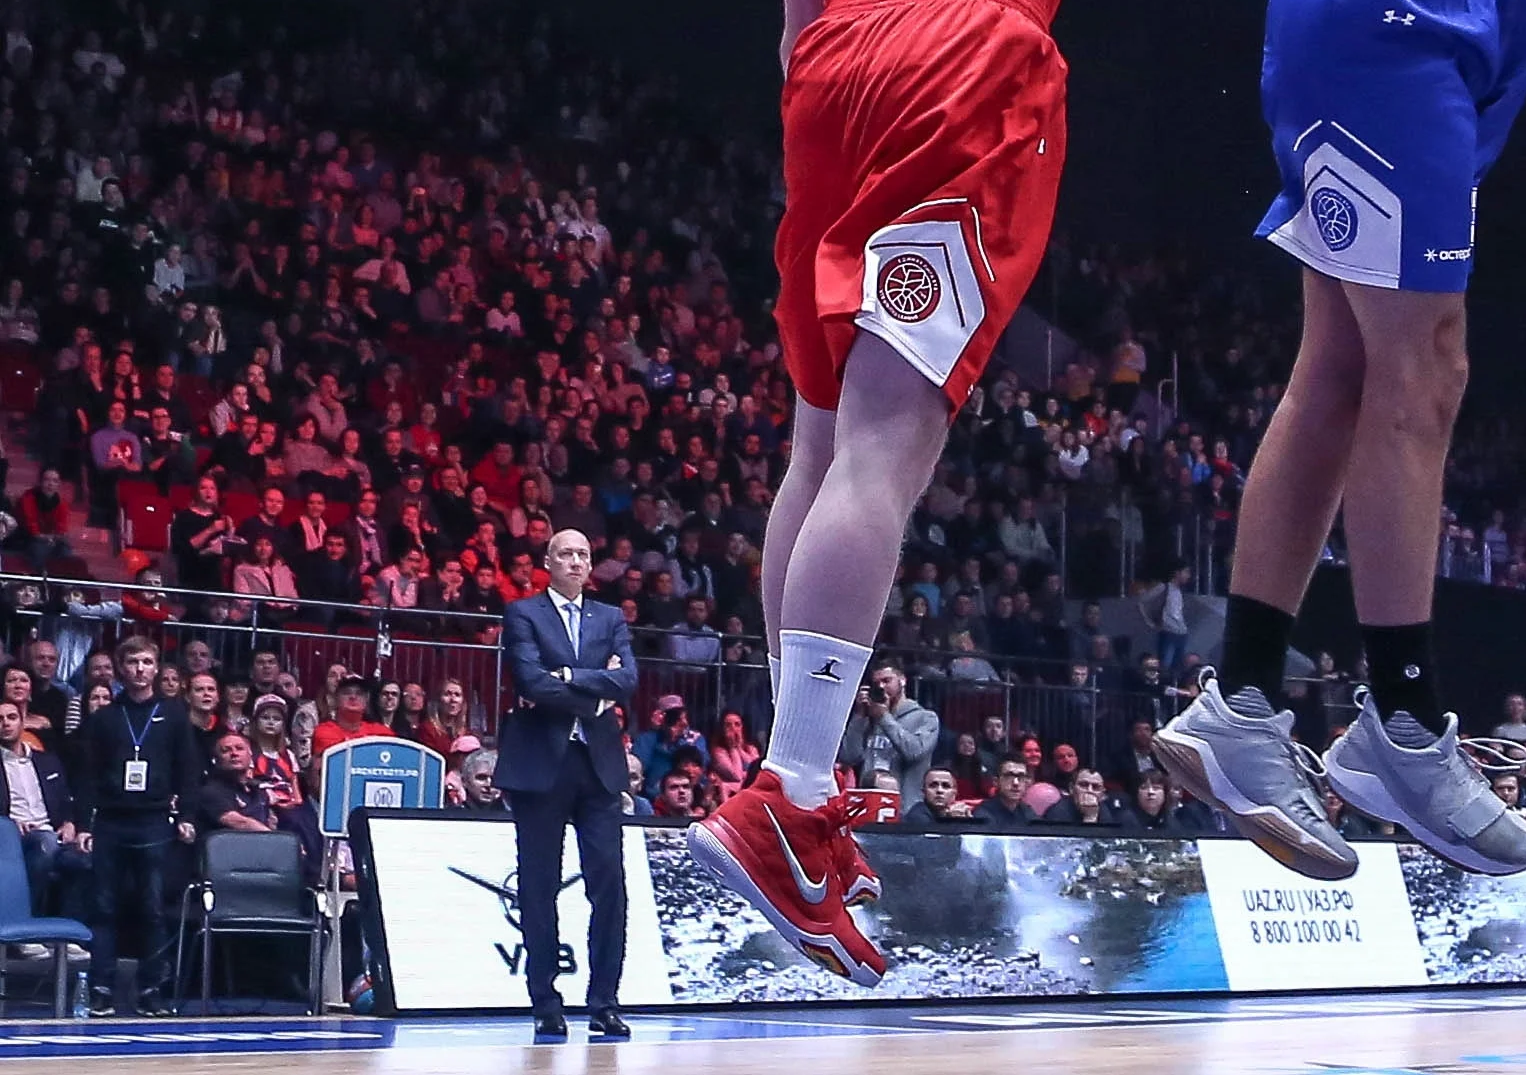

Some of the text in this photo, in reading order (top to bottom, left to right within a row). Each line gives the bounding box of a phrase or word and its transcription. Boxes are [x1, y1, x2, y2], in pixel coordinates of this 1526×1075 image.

[1250, 919, 1362, 943] 8 800 100 00 42
[494, 942, 578, 976] УЗ
